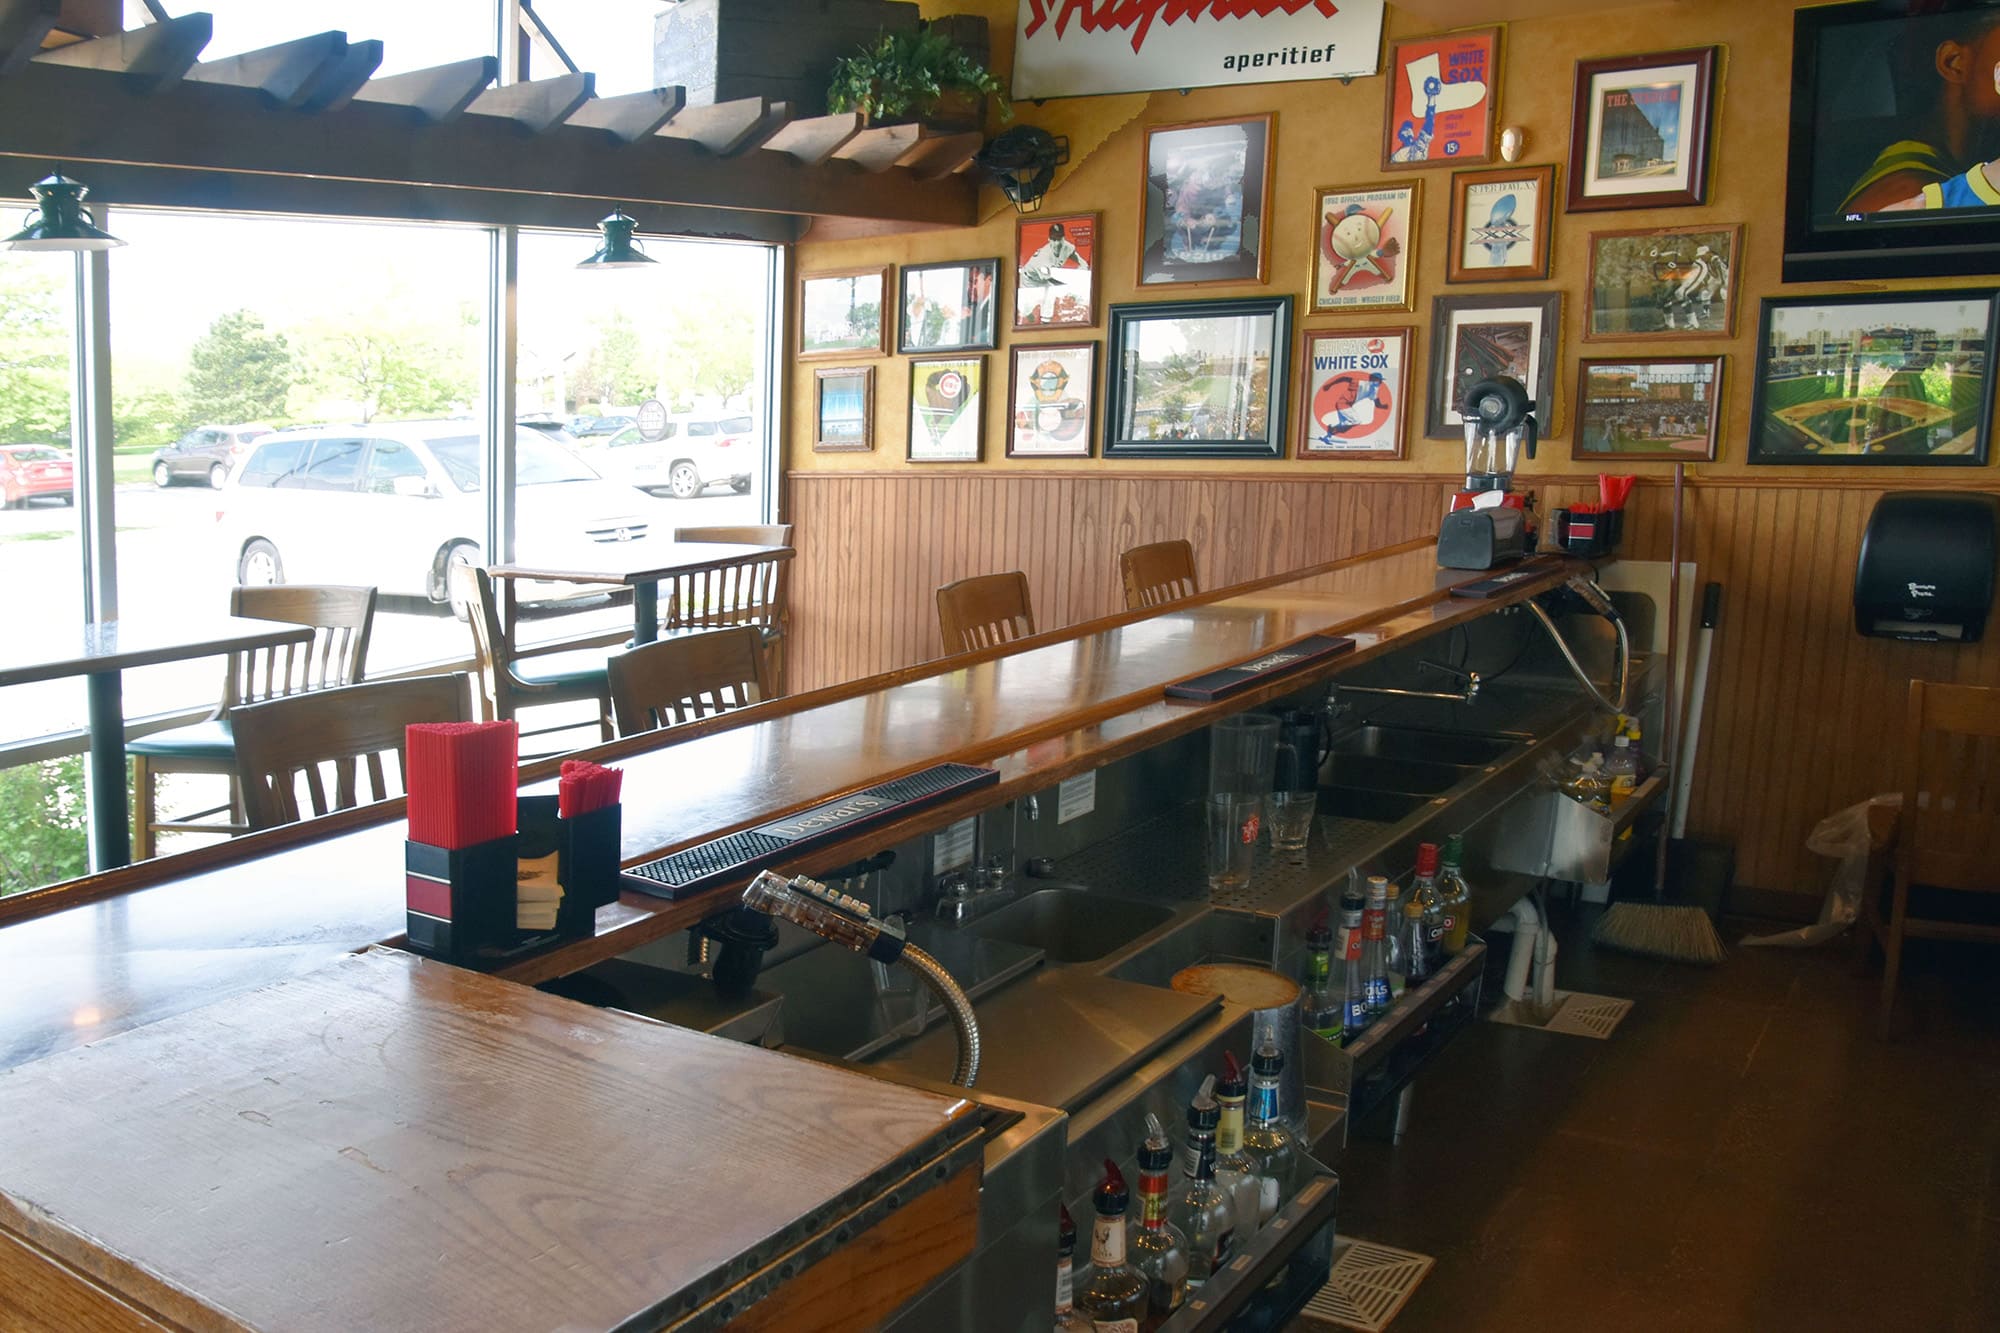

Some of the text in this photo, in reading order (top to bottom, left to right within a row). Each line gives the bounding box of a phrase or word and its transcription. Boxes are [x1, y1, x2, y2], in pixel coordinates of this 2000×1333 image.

[1223, 44, 1336, 72] aperitief
[1448, 49, 1484, 66] WHITE
[1448, 67, 1483, 84] SOX
[1607, 93, 1629, 107] THE
[1314, 354, 1389, 370] WHITE SOX
